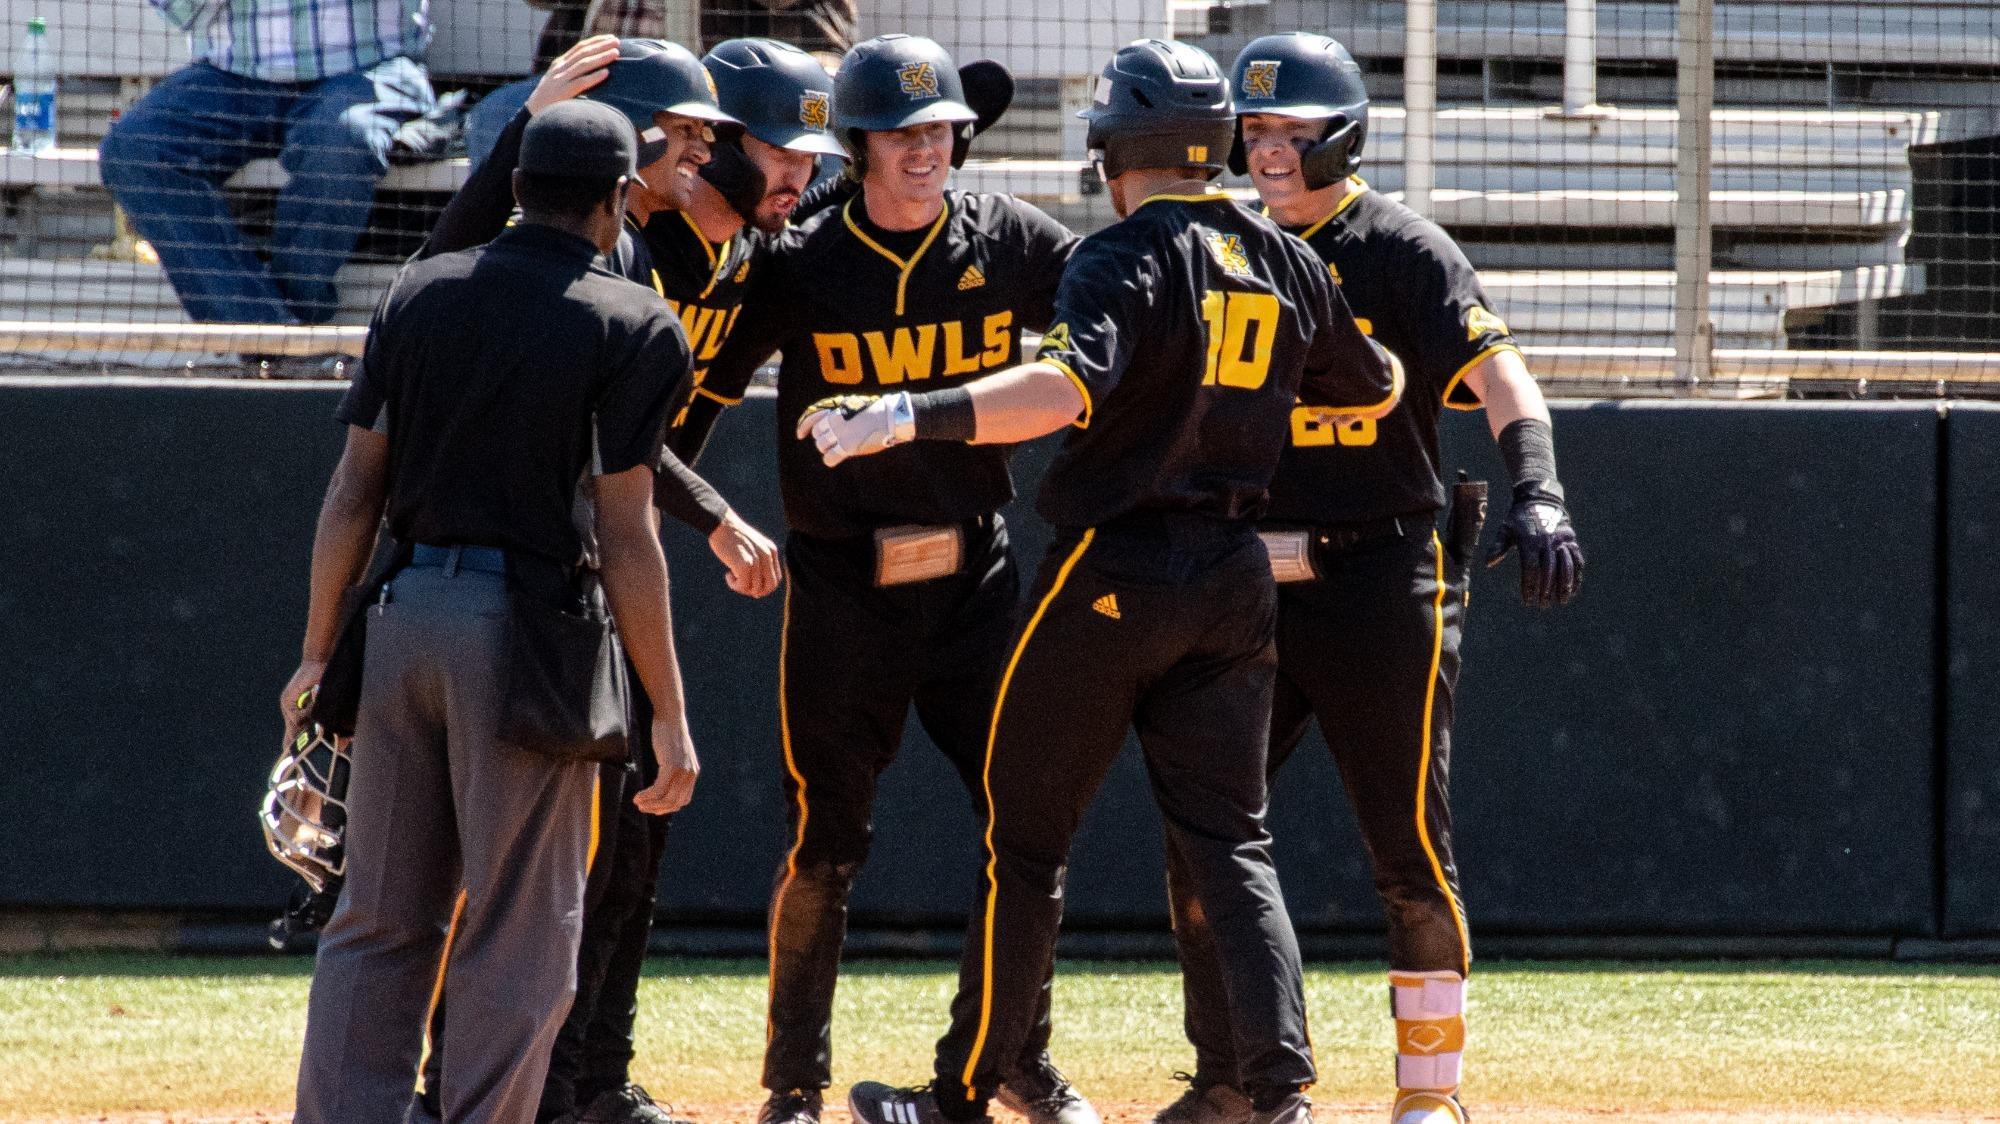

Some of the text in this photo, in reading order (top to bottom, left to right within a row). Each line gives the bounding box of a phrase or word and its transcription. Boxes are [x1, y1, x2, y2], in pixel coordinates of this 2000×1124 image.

[667, 298, 742, 360] WL
[812, 309, 1013, 386] OWLS
[1201, 289, 1280, 390] 10
